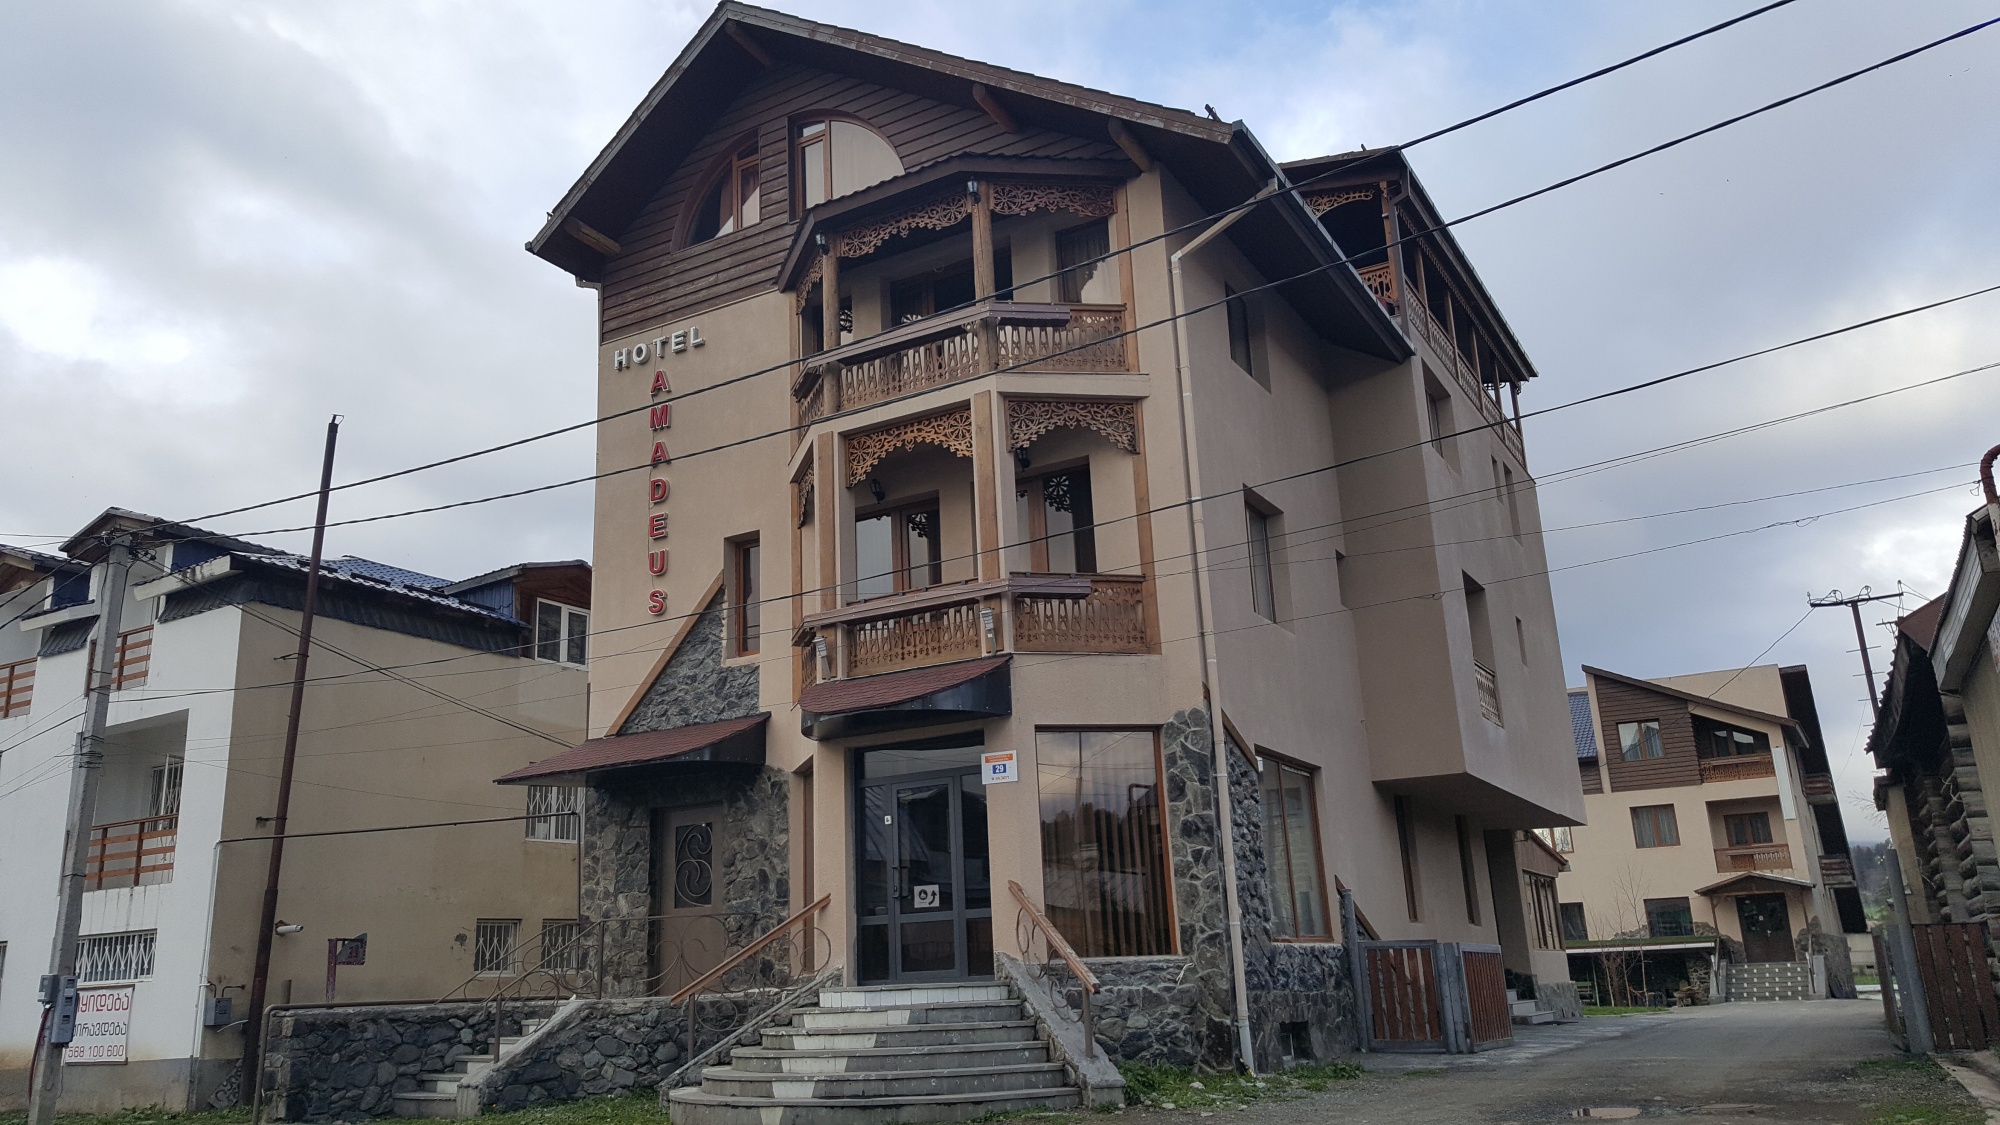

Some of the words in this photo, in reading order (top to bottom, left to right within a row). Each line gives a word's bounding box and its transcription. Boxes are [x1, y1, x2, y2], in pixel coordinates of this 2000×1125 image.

[614, 326, 705, 371] HOTEL
[648, 368, 672, 616] AMADEUS
[995, 764, 1004, 773] 29
[68, 1046, 85, 1058] 568
[89, 1045, 104, 1058] 100
[106, 1044, 124, 1057] 600
